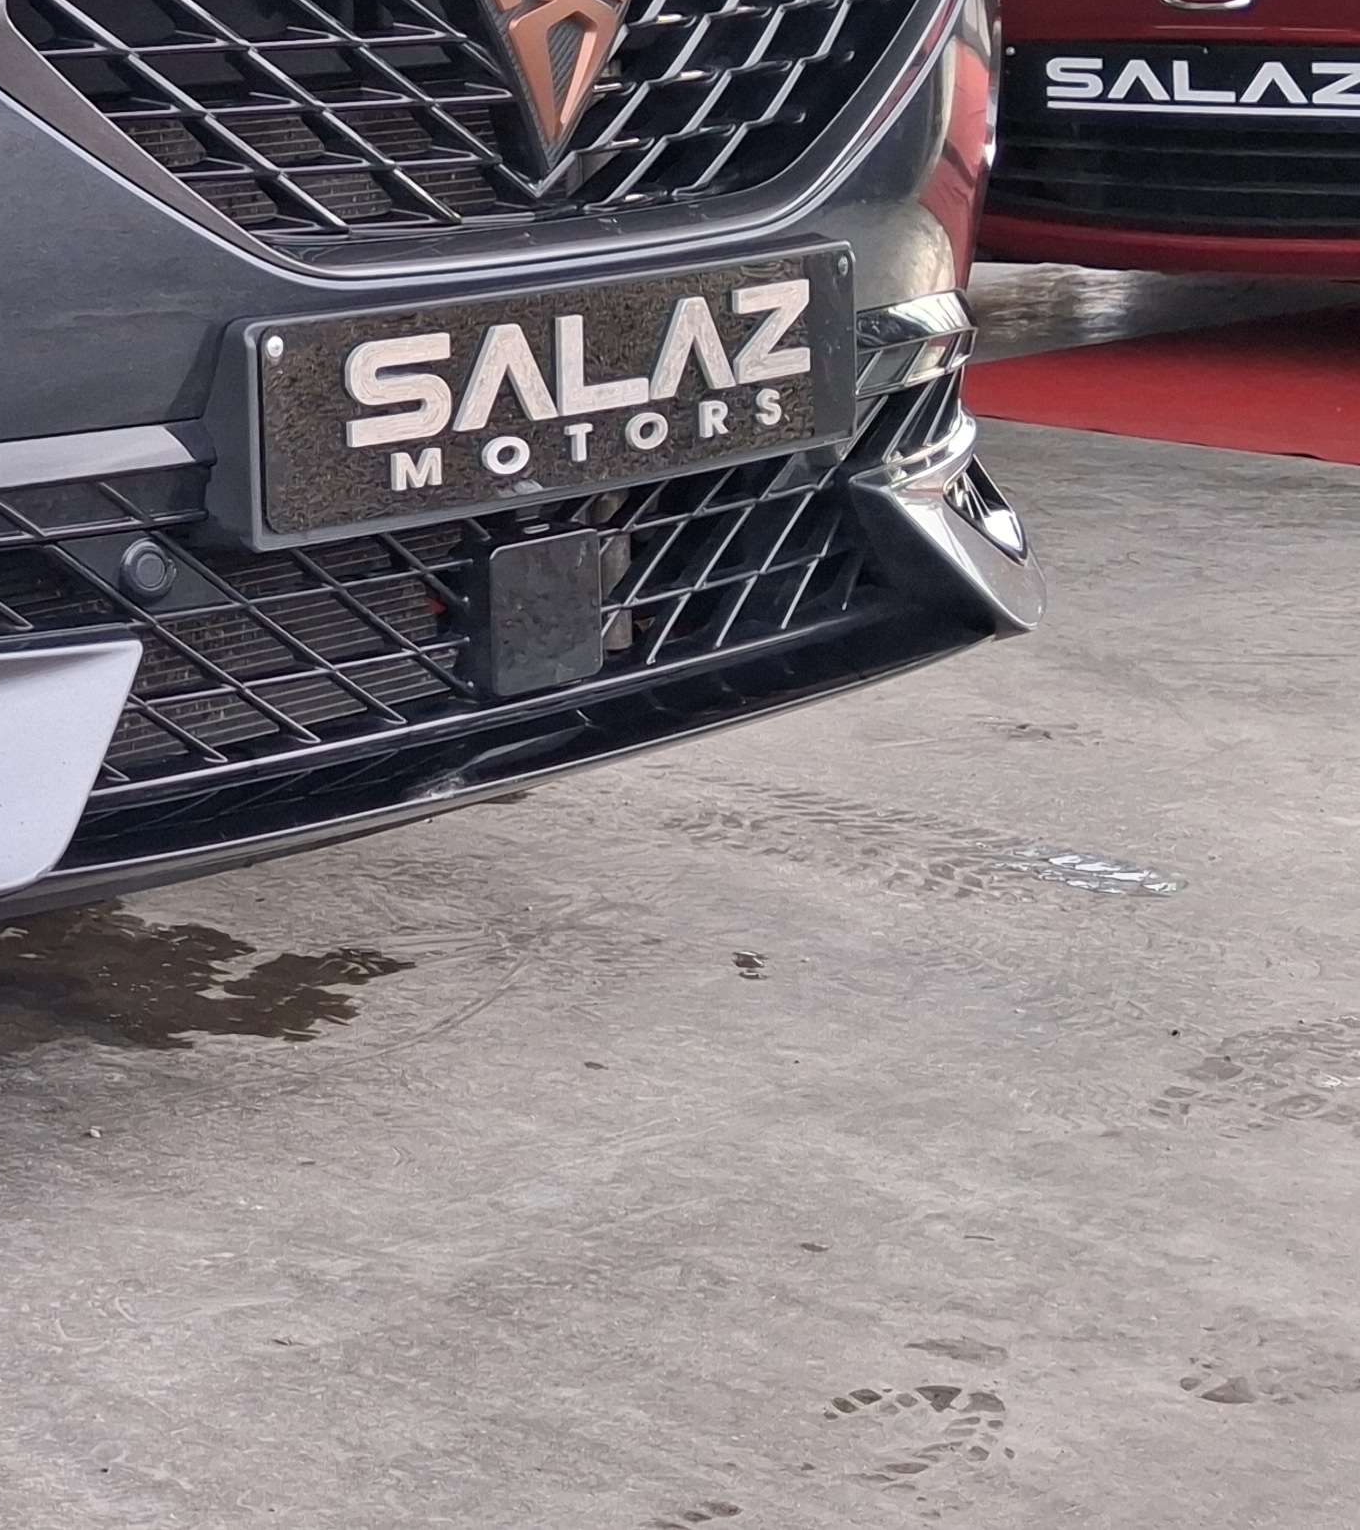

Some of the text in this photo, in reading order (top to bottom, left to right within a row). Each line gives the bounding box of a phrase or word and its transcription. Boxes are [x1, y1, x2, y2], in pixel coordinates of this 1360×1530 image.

[1045, 56, 1360, 105] SALAZ
[343, 278, 811, 448] SALAZ
[390, 387, 786, 492] MOTORS
